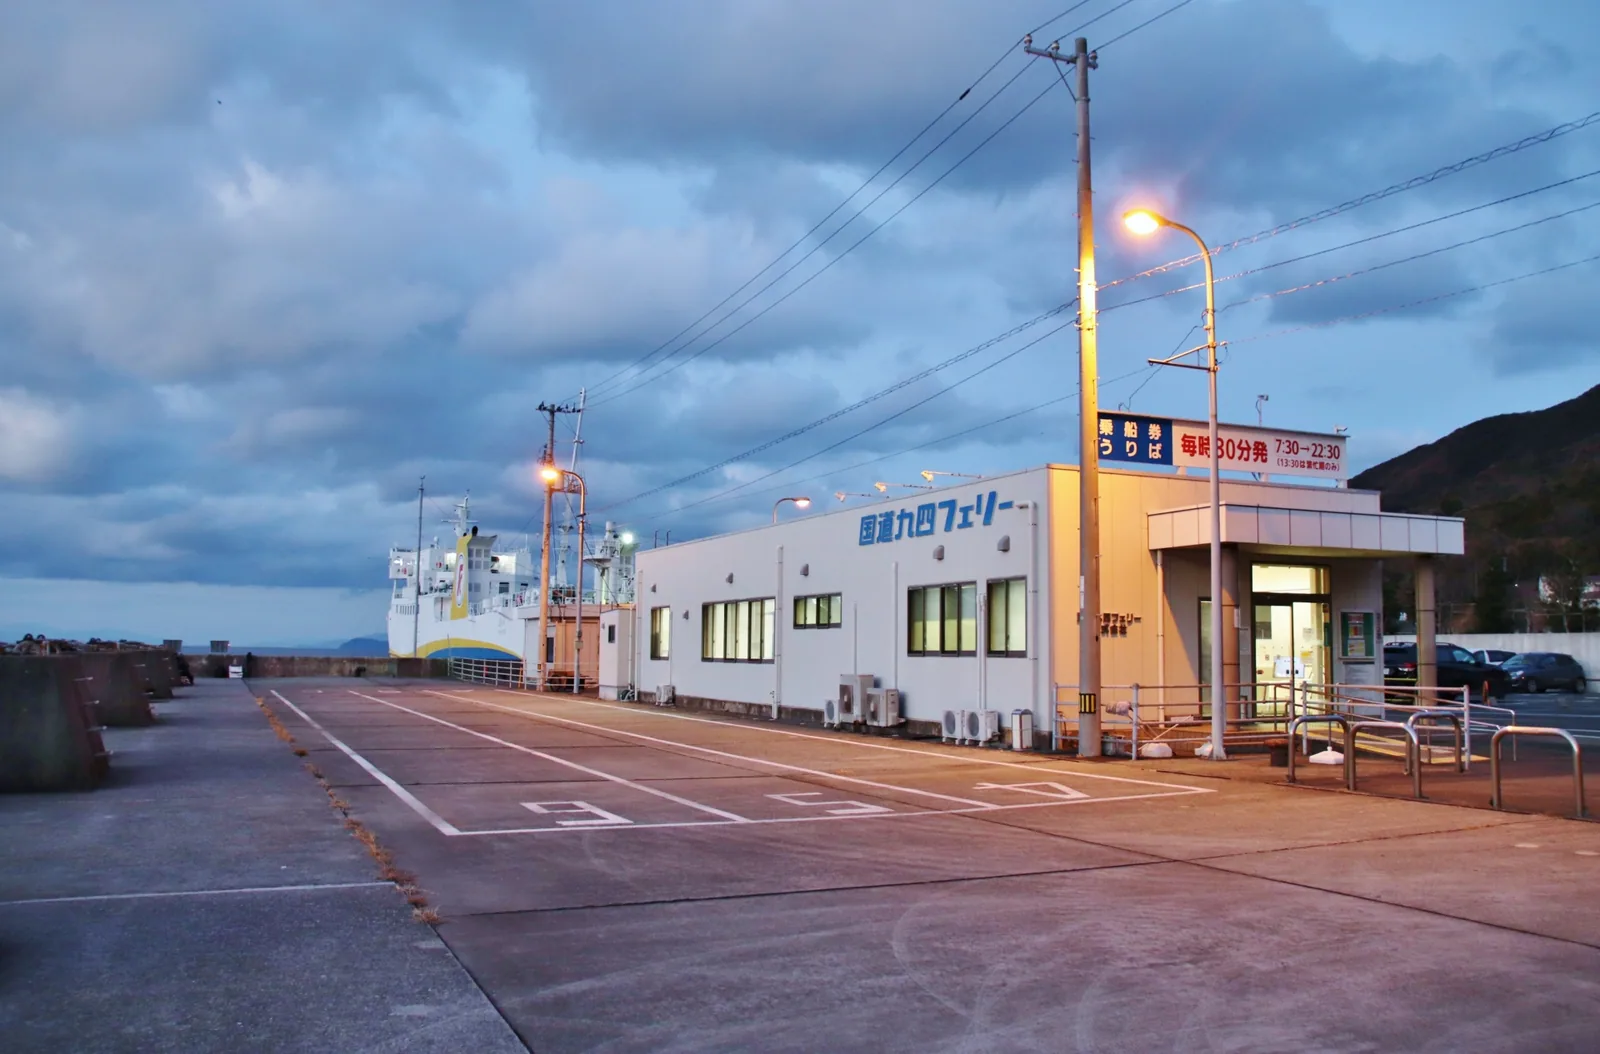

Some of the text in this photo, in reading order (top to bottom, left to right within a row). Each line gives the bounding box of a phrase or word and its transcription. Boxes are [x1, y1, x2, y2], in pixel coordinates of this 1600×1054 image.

[1099, 419, 1162, 440] 乗船券
[1100, 438, 1162, 459] うりば
[1181, 433, 1268, 463] 毎時30分発
[859, 491, 1014, 546] 国道九四フェリー
